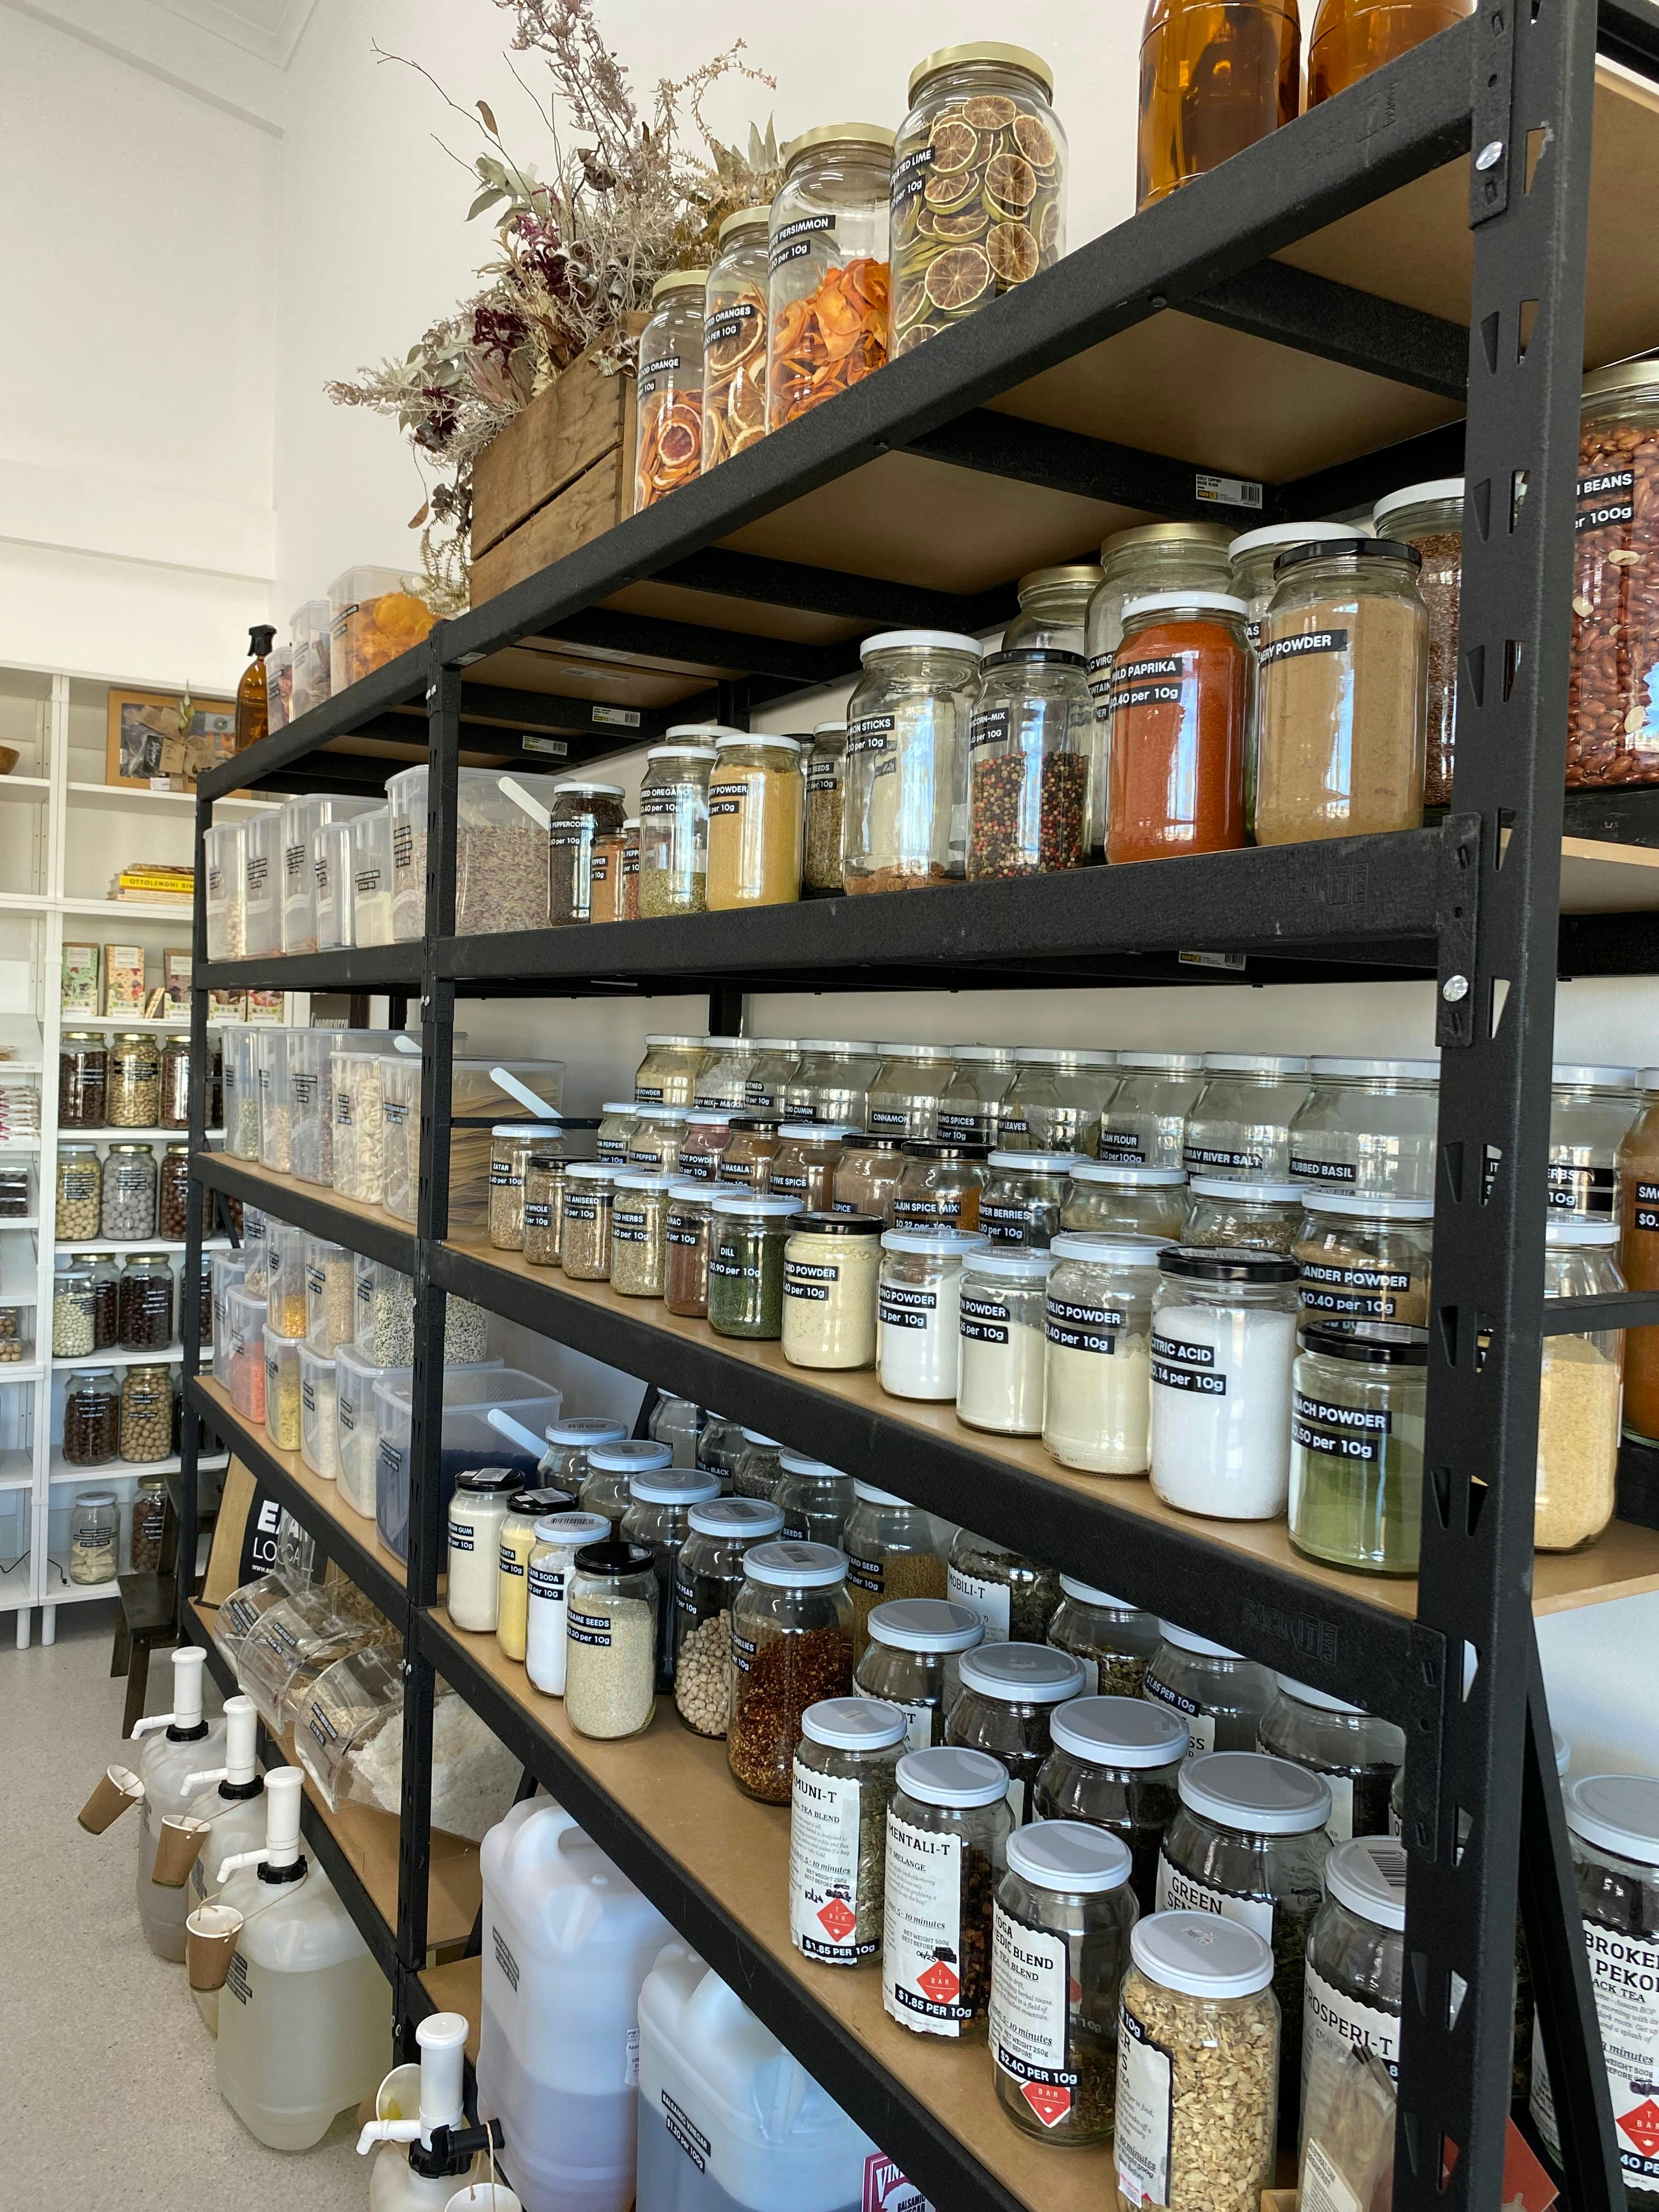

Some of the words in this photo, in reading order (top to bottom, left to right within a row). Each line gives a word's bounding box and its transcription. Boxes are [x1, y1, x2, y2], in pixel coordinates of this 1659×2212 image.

[912, 149, 932, 166] LIME
[907, 179, 922, 194] 10g
[779, 218, 828, 241] PERSIMMON
[792, 244, 808, 256] 10g
[715, 306, 751, 322] ORANGES
[710, 331, 720, 342] PER
[722, 325, 736, 336] 10G
[651, 358, 679, 371] ORANGE
[645, 383, 654, 392] 10g
[1584, 473, 1632, 493] BEANS
[1590, 507, 1631, 523] 100g
[1276, 635, 1331, 655] POWDER
[1128, 661, 1176, 677] PAPRIKA
[1131, 691, 1150, 704] per
[1154, 687, 1178, 699] 10g
[862, 719, 891, 731] STICKS
[988, 730, 1002, 738] 10G
[868, 738, 884, 747] 10g
[812, 764, 830, 773] SEEDS
[652, 788, 689, 796] OREGANO
[716, 785, 747, 794] POWDER
[666, 803, 680, 811] 10g
[129, 878, 178, 887] OTTOLENGHI
[873, 1113, 909, 1123] CINNAMON
[951, 1116, 974, 1125] SPICES
[1005, 1122, 1026, 1131] LEAVES
[953, 1132, 966, 1141] 10g
[1114, 1135, 1137, 1146] FLOUR
[1203, 1152, 1231, 1164] RIVER
[1233, 1154, 1260, 1166] SALT
[693, 1168, 707, 1176] 10g
[725, 1164, 749, 1173] MASALA
[1291, 1161, 1319, 1174] RUBBED
[1321, 1165, 1353, 1178] BASIL
[773, 1176, 783, 1184] FIVE
[571, 1196, 599, 1205] ANISEED
[1549, 1192, 1576, 1206] 10g
[894, 1201, 911, 1211] CAJUN
[912, 1203, 936, 1211] SPICE
[938, 1204, 958, 1213] MIX
[580, 1210, 594, 1218] 10g
[622, 1215, 644, 1223] HERBS
[994, 1208, 1031, 1220] BERRIES
[536, 1217, 548, 1226] 10g
[634, 1232, 649, 1241] 10g
[681, 1235, 696, 1244] 10g
[1004, 1227, 1023, 1239] 10g
[720, 1247, 735, 1257] DILL
[726, 1266, 740, 1276] per
[743, 1267, 761, 1277] 10g
[796, 1266, 836, 1278] POWDER
[1344, 1272, 1407, 1287] POWDER
[791, 1286, 804, 1295] per
[806, 1287, 825, 1298] 10g
[891, 1291, 935, 1305] POWDER
[966, 1302, 1006, 1317] POWDER
[1336, 1299, 1361, 1311] per
[1366, 1300, 1393, 1314] 10g
[888, 1313, 901, 1322] per
[905, 1314, 924, 1327] 10g
[1066, 1307, 1120, 1324] POWDER
[967, 1325, 979, 1335] per
[983, 1327, 1004, 1341] 10g
[1061, 1333, 1080, 1345] per
[1083, 1335, 1108, 1351] 10g
[1177, 1347, 1211, 1362] ACID
[1170, 1374, 1192, 1386] per
[1195, 1375, 1224, 1392] 10g
[1318, 1406, 1386, 1429] POWDER
[1313, 1435, 1336, 1451] per
[1341, 1440, 1372, 1458] 10g
[711, 1466, 730, 1476] BLACK
[458, 1527, 472, 1535] GUM
[783, 1528, 803, 1538] SEEDS
[461, 1541, 473, 1550] 10g
[511, 1565, 522, 1575] 10g
[862, 1561, 879, 1572] SEED
[539, 1572, 558, 1583] SODA
[681, 1584, 694, 1598] PEAS
[865, 1579, 878, 1591] 10g
[948, 1572, 986, 1600] MOBILI-T
[544, 1589, 558, 1598] 10G
[686, 1602, 697, 1615] 10g
[585, 1618, 610, 1627] SEEDS
[580, 1633, 592, 1643] per
[594, 1635, 610, 1645] 10g
[733, 1635, 754, 1652] CHILLIES
[738, 1658, 749, 1671] 10g
[1161, 1688, 1175, 1702] PER
[1177, 1696, 1196, 1714] 10g
[801, 1804, 812, 1815] TEA
[814, 1810, 840, 1824] BLEND
[893, 1852, 927, 1872] MELANGE
[821, 1864, 851, 1875] minutes
[815, 1872, 833, 1881] WEIGHT
[1172, 1876, 1223, 1916] GREEN
[829, 1914, 845, 1922] BAR
[913, 1916, 945, 1929] minutes
[913, 1933, 934, 1944] WEIGHT
[913, 1940, 934, 1950] BEFORE
[805, 1940, 831, 1955] $1.85
[833, 1944, 852, 1956] PER
[855, 1944, 875, 1954] 10g
[1013, 1945, 1053, 1970] BLEND
[999, 1951, 1010, 1967] TEA
[1011, 1963, 1039, 1982] BLEND
[931, 1977, 950, 1986] BAR
[1621, 1988, 1645, 2003] TEA
[898, 1990, 924, 2010] $1.85
[926, 2002, 947, 2016] PER
[950, 2006, 972, 2018] 10g
[1124, 2012, 1141, 2038] 10g
[1018, 2027, 1053, 2046] minutes
[1012, 2036, 1032, 2051] WEIGHT
[1012, 2043, 1032, 2059] BEFORE
[1609, 2043, 1654, 2064] minutes
[1000, 2050, 1025, 2075] $2.40
[1027, 2068, 1049, 2083] PER
[1053, 2072, 1077, 2085] 10g
[1038, 2088, 1058, 2098] BAR
[662, 2093, 686, 2125] BALSAMIC
[686, 2120, 708, 2151] VINEGAR
[667, 2118, 681, 2139] $1.20
[690, 2147, 703, 2169] 100g
[1126, 2141, 1156, 2171] minutes
[897, 2194, 926, 2212] BALSAMIC
